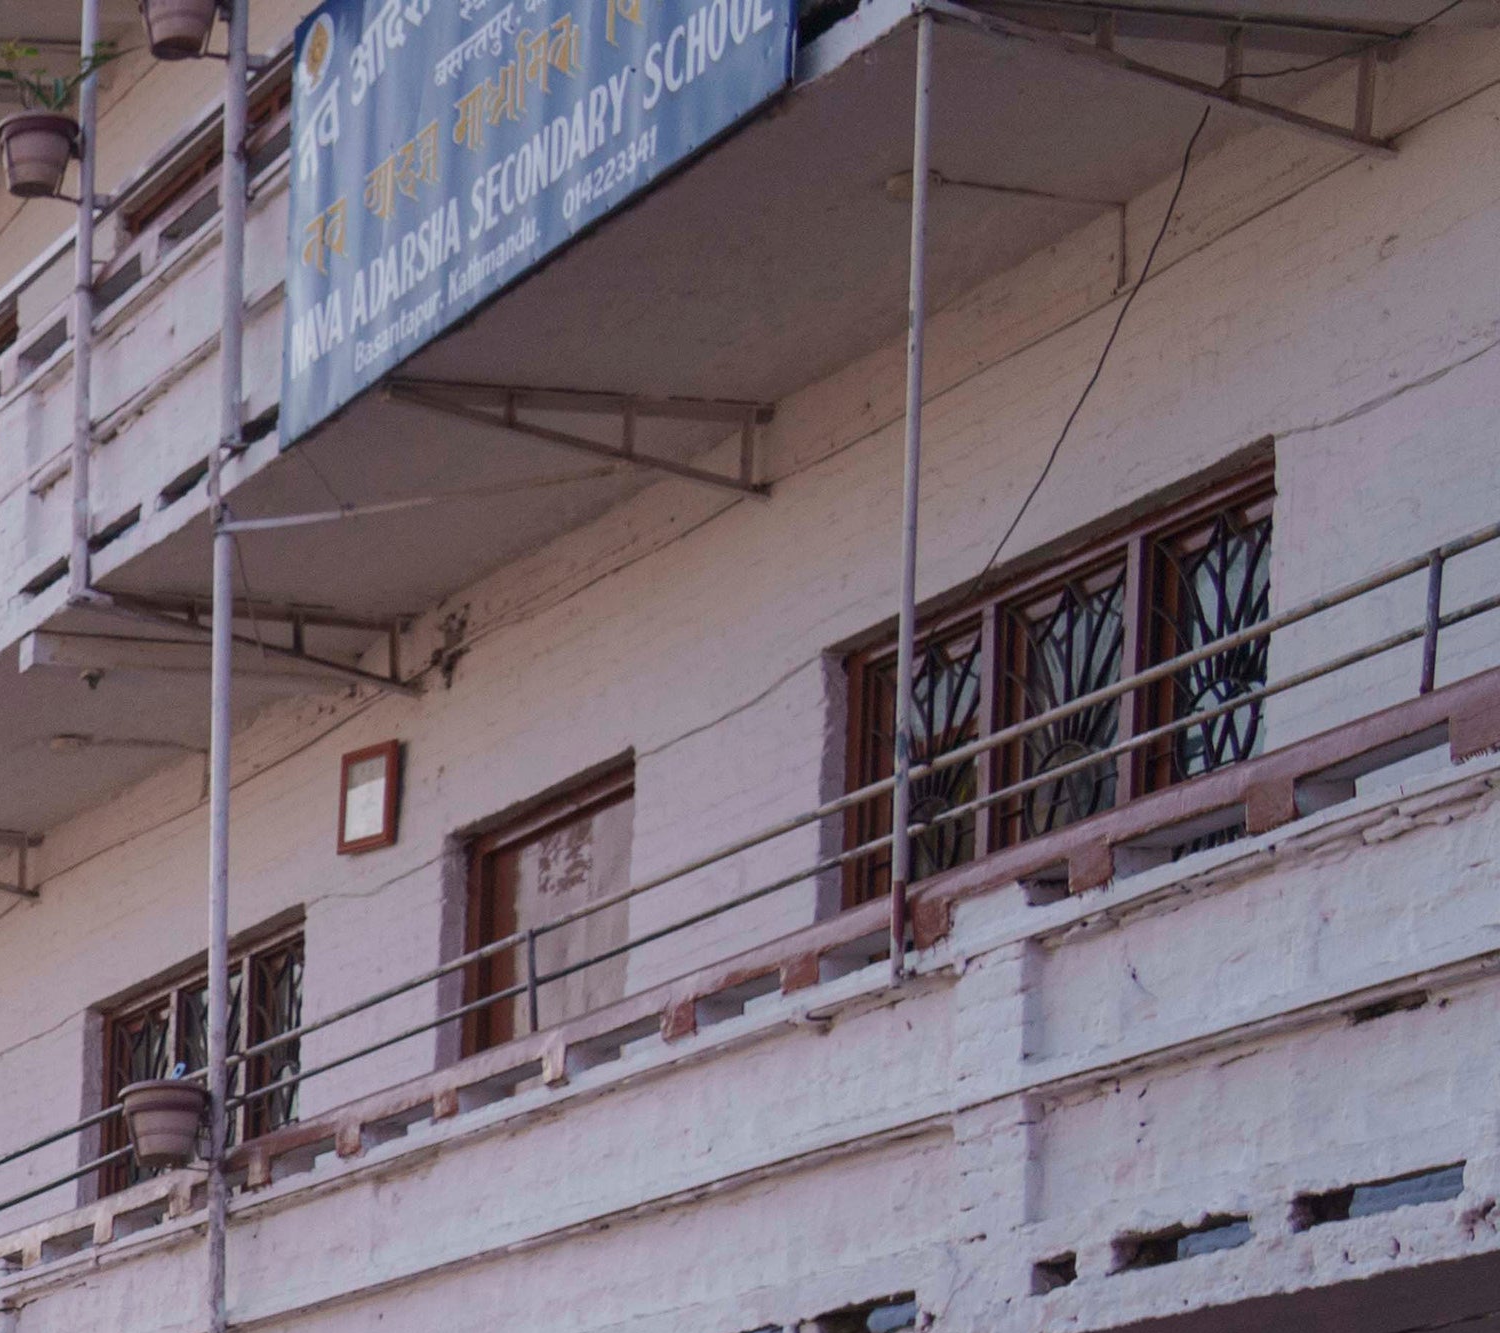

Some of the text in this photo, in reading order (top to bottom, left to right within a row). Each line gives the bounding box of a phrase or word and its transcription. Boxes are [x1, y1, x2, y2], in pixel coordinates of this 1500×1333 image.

[291, 0, 775, 380] NAVA ADARSHA SECONDARY SCHOOL
[562, 124, 658, 220] 014223341
